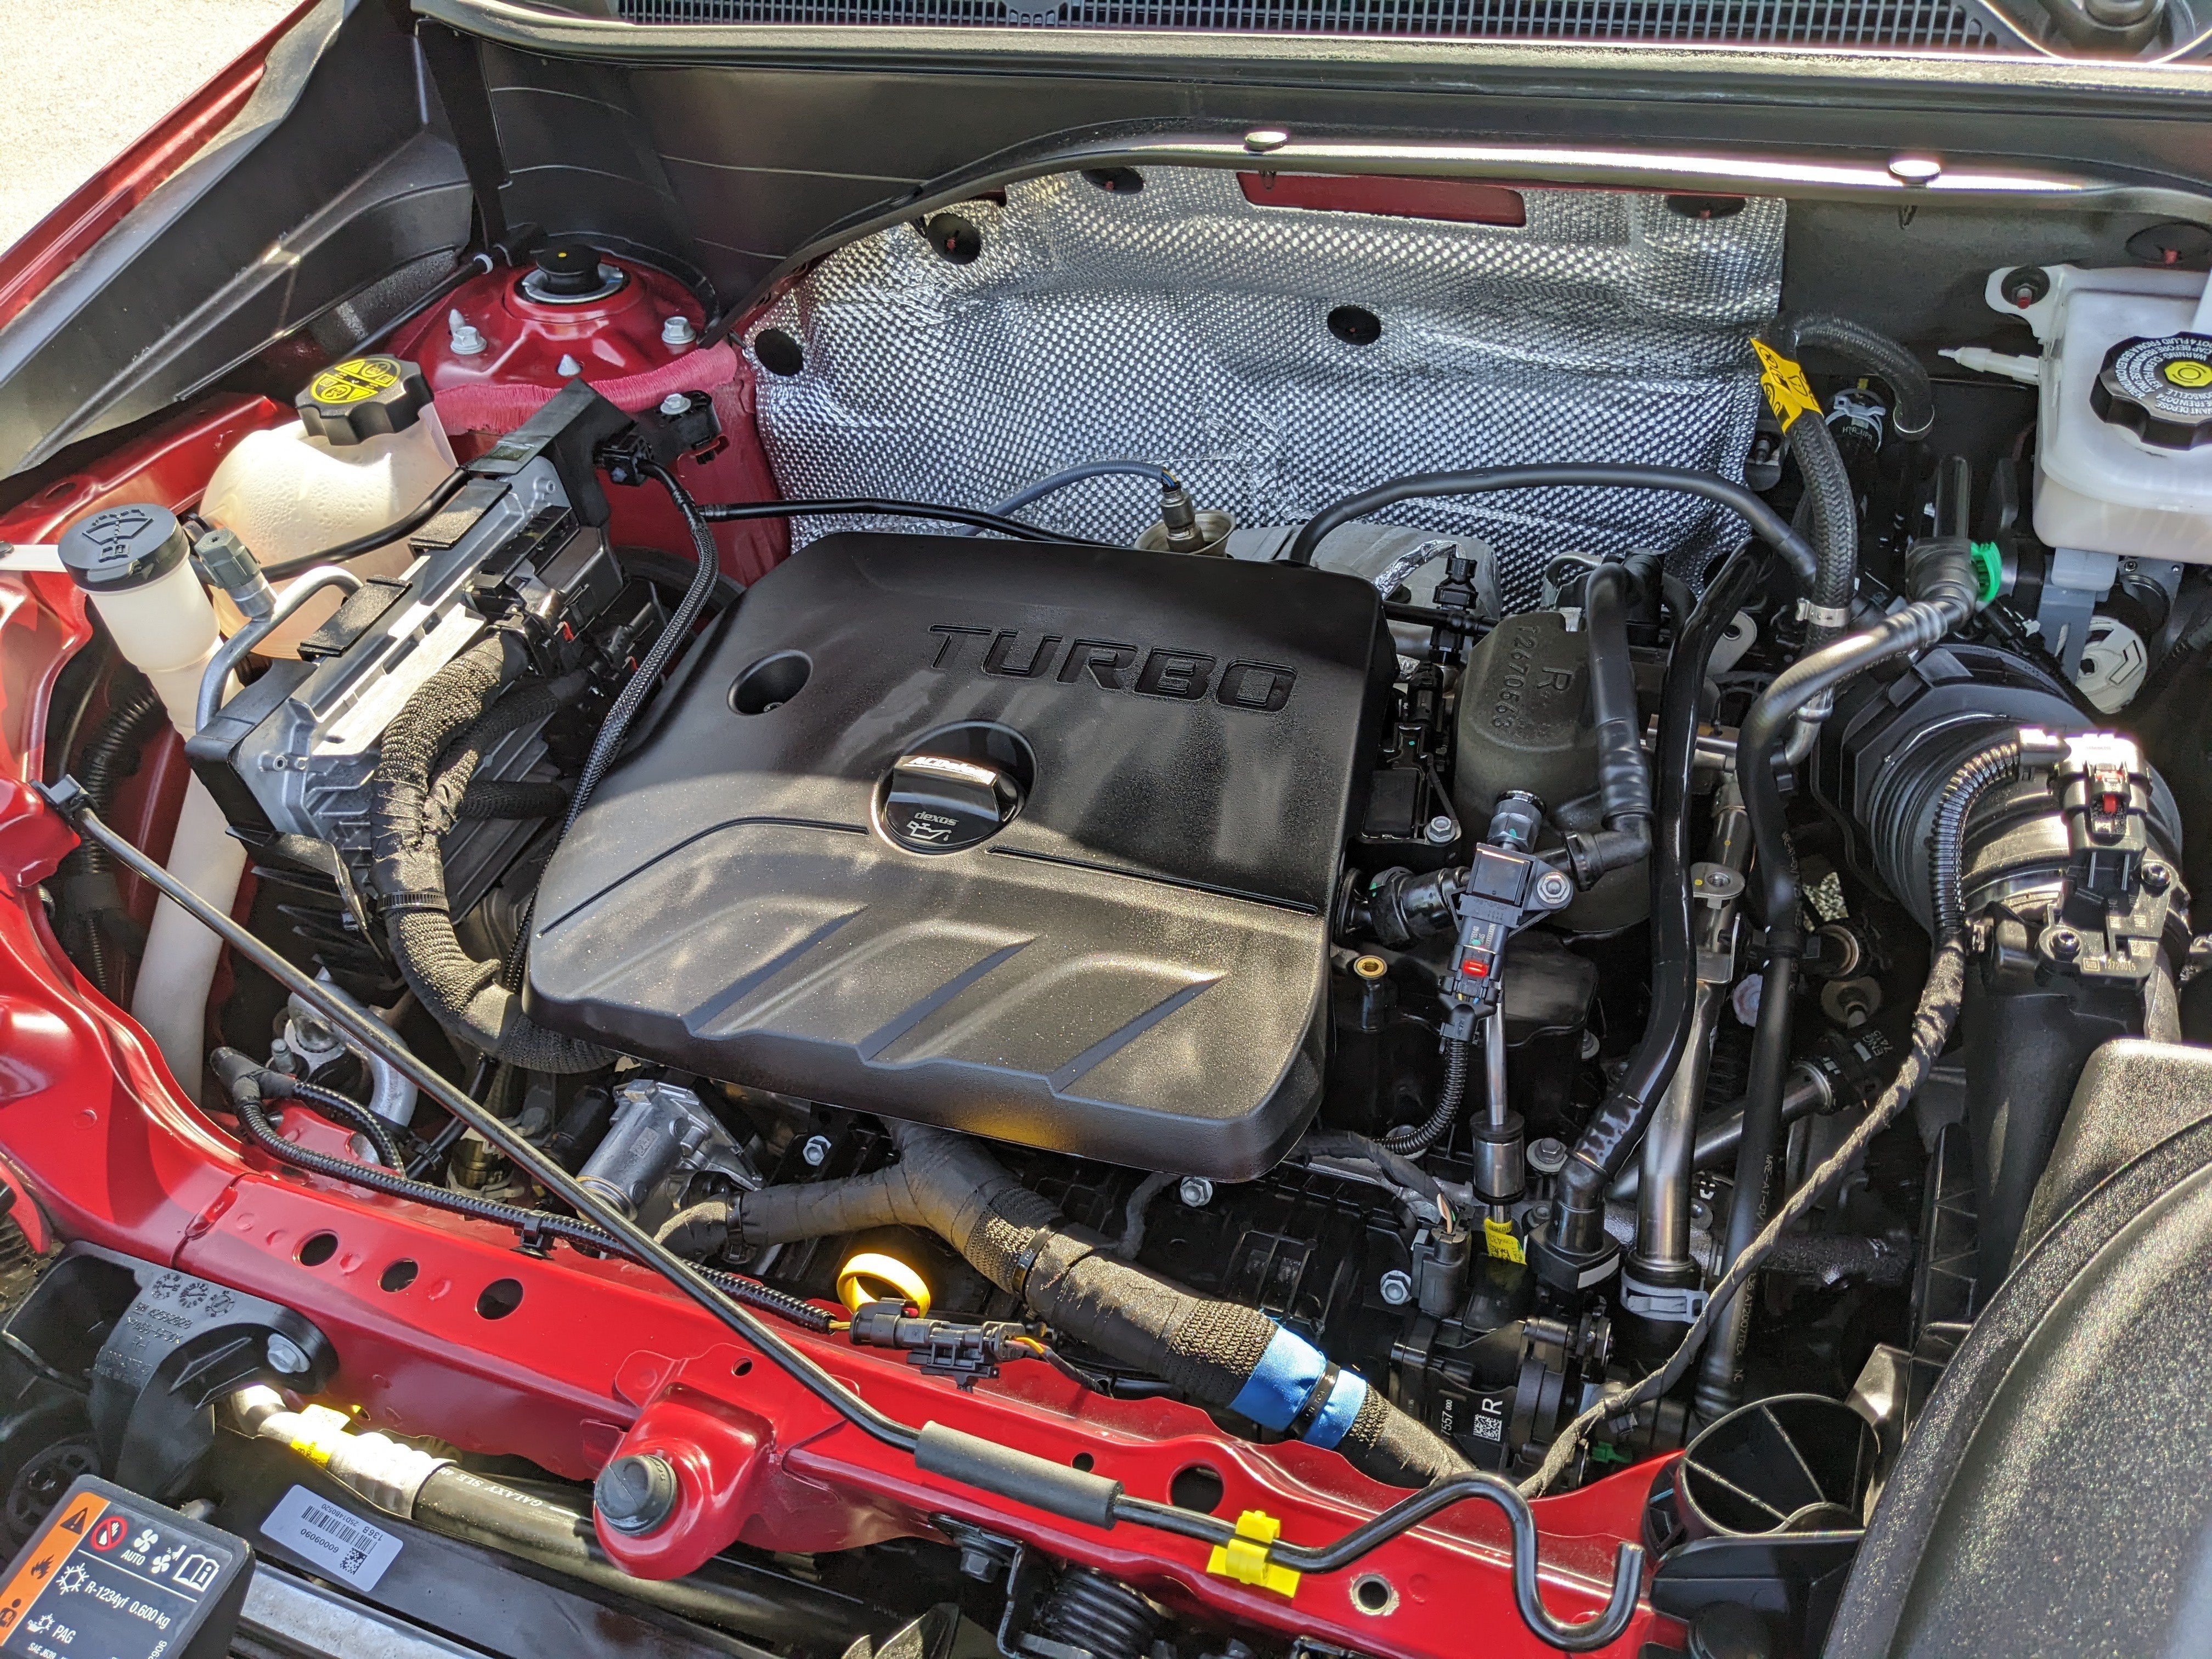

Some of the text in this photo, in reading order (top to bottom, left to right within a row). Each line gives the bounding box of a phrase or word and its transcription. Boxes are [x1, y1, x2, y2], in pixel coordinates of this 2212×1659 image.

[2155, 345, 2191, 353] BEFORE
[2192, 345, 2212, 354] CAP
[2163, 395, 2180, 404] DOT
[2180, 399, 2204, 407] FREIN
[929, 624, 1297, 713] TURBO
[1492, 625, 1538, 729] 12670563
[1537, 665, 1575, 692] R
[915, 811, 959, 826] dexos
[1863, 1034, 1884, 1056] ENG
[1735, 1368, 1744, 1382] NC
[1482, 1397, 1503, 1415] R
[456, 1474, 484, 1487] SLE
[483, 1485, 543, 1506] GALAXY
[301, 1528, 340, 1554] 60009090
[362, 1526, 383, 1542] 136B
[120, 1549, 146, 1566] AUTO
[84, 1582, 172, 1630] R-1234yf 0.600 kg
[52, 1624, 77, 1645] PAG
[27, 1642, 43, 1655] SAE
